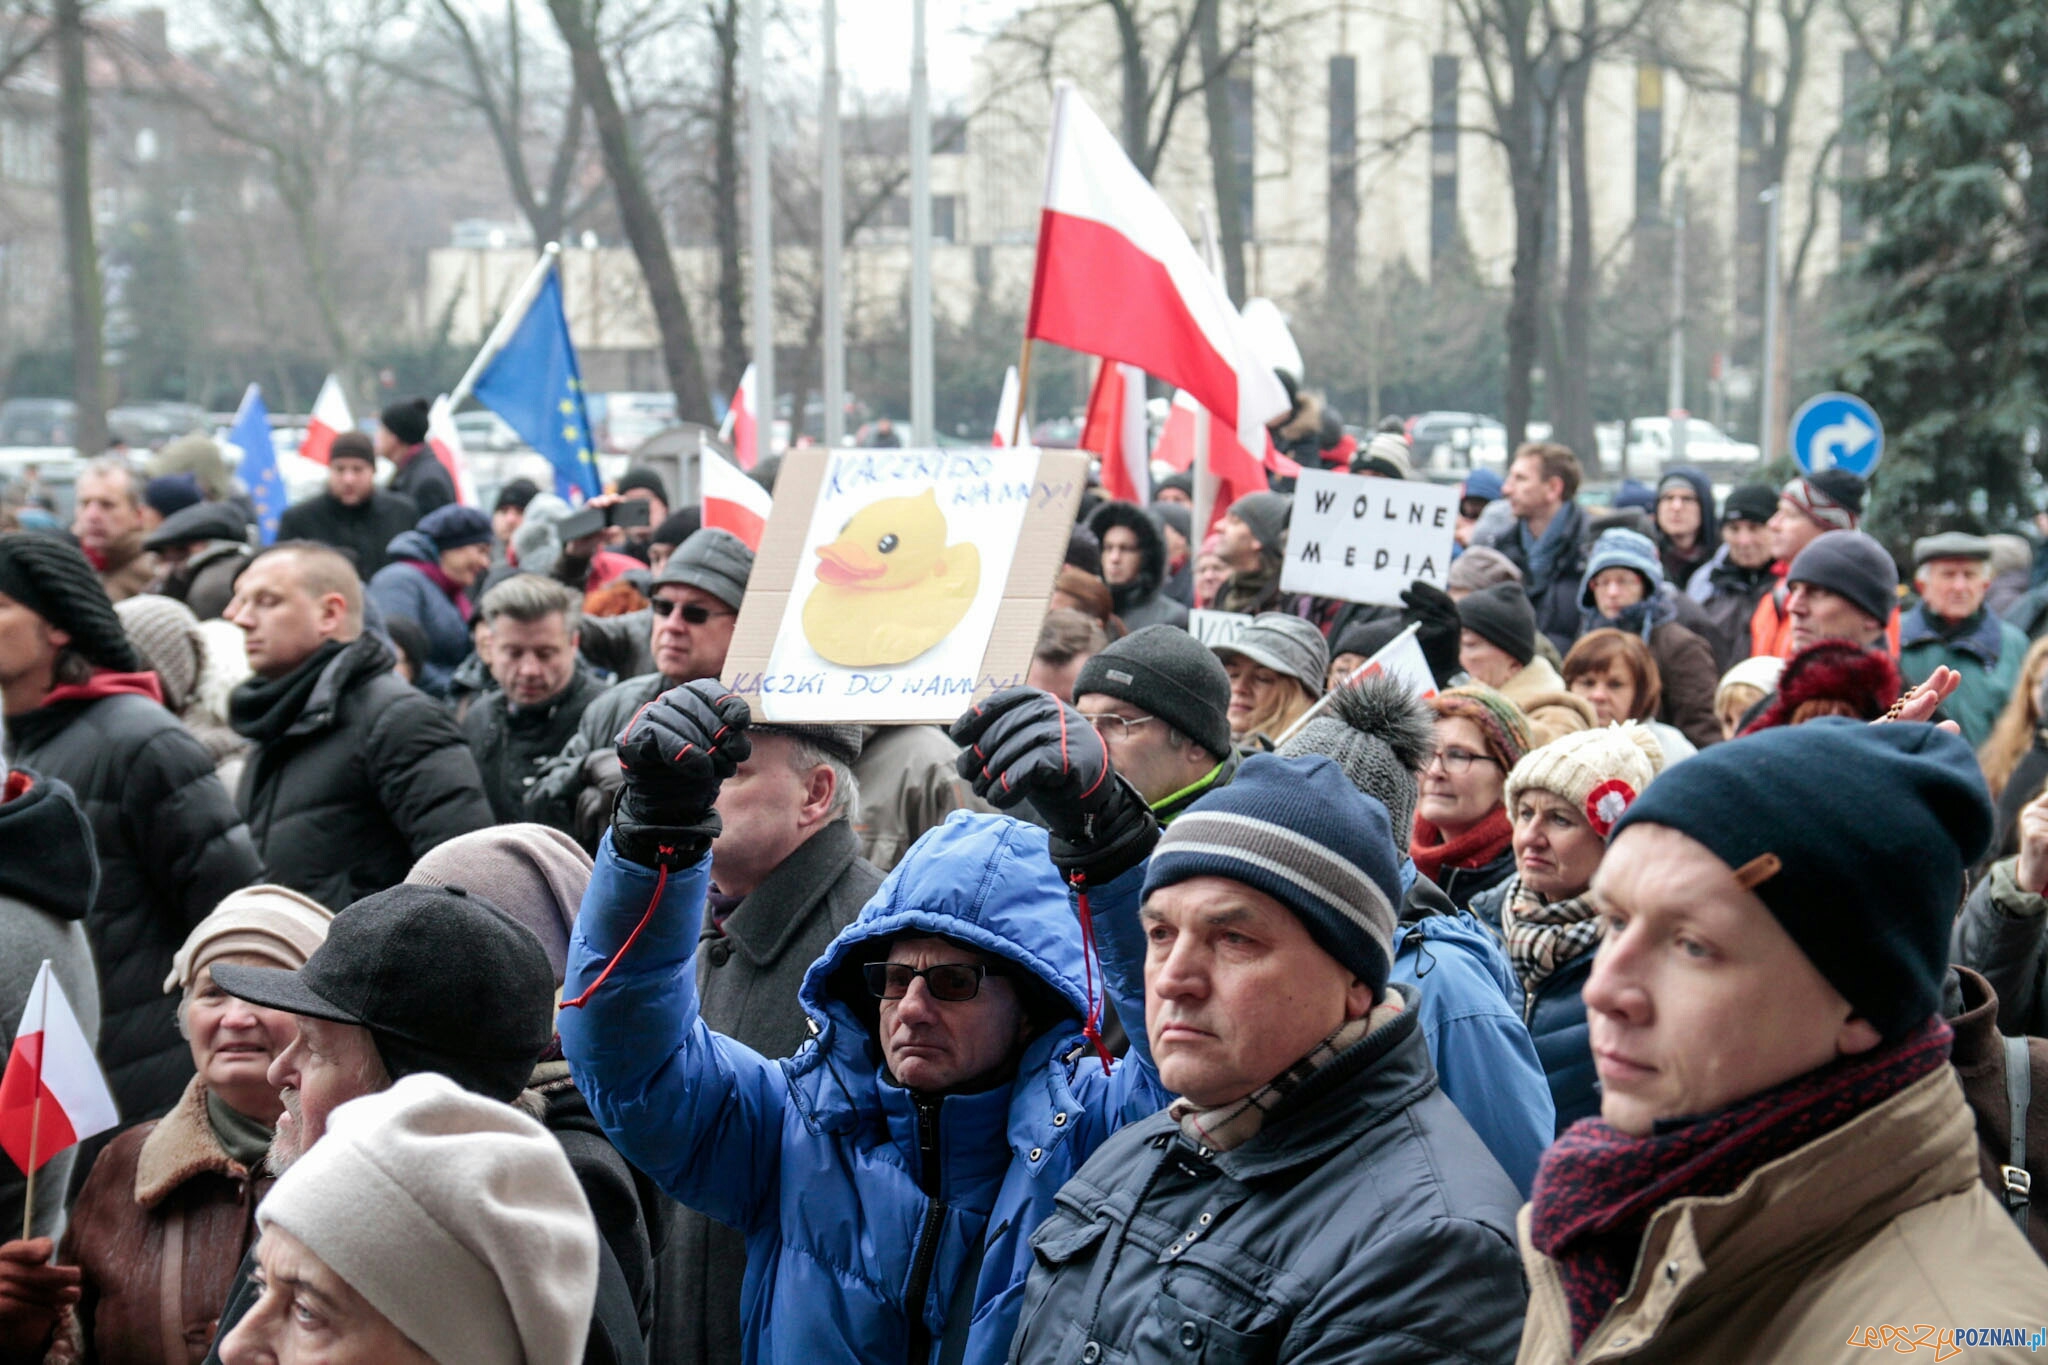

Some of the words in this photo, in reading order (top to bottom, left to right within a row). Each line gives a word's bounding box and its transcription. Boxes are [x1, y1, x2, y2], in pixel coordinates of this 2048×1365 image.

[1315, 490, 1448, 528] WOLNE
[1301, 541, 1437, 579] MEDIA
[844, 674, 894, 696] DO
